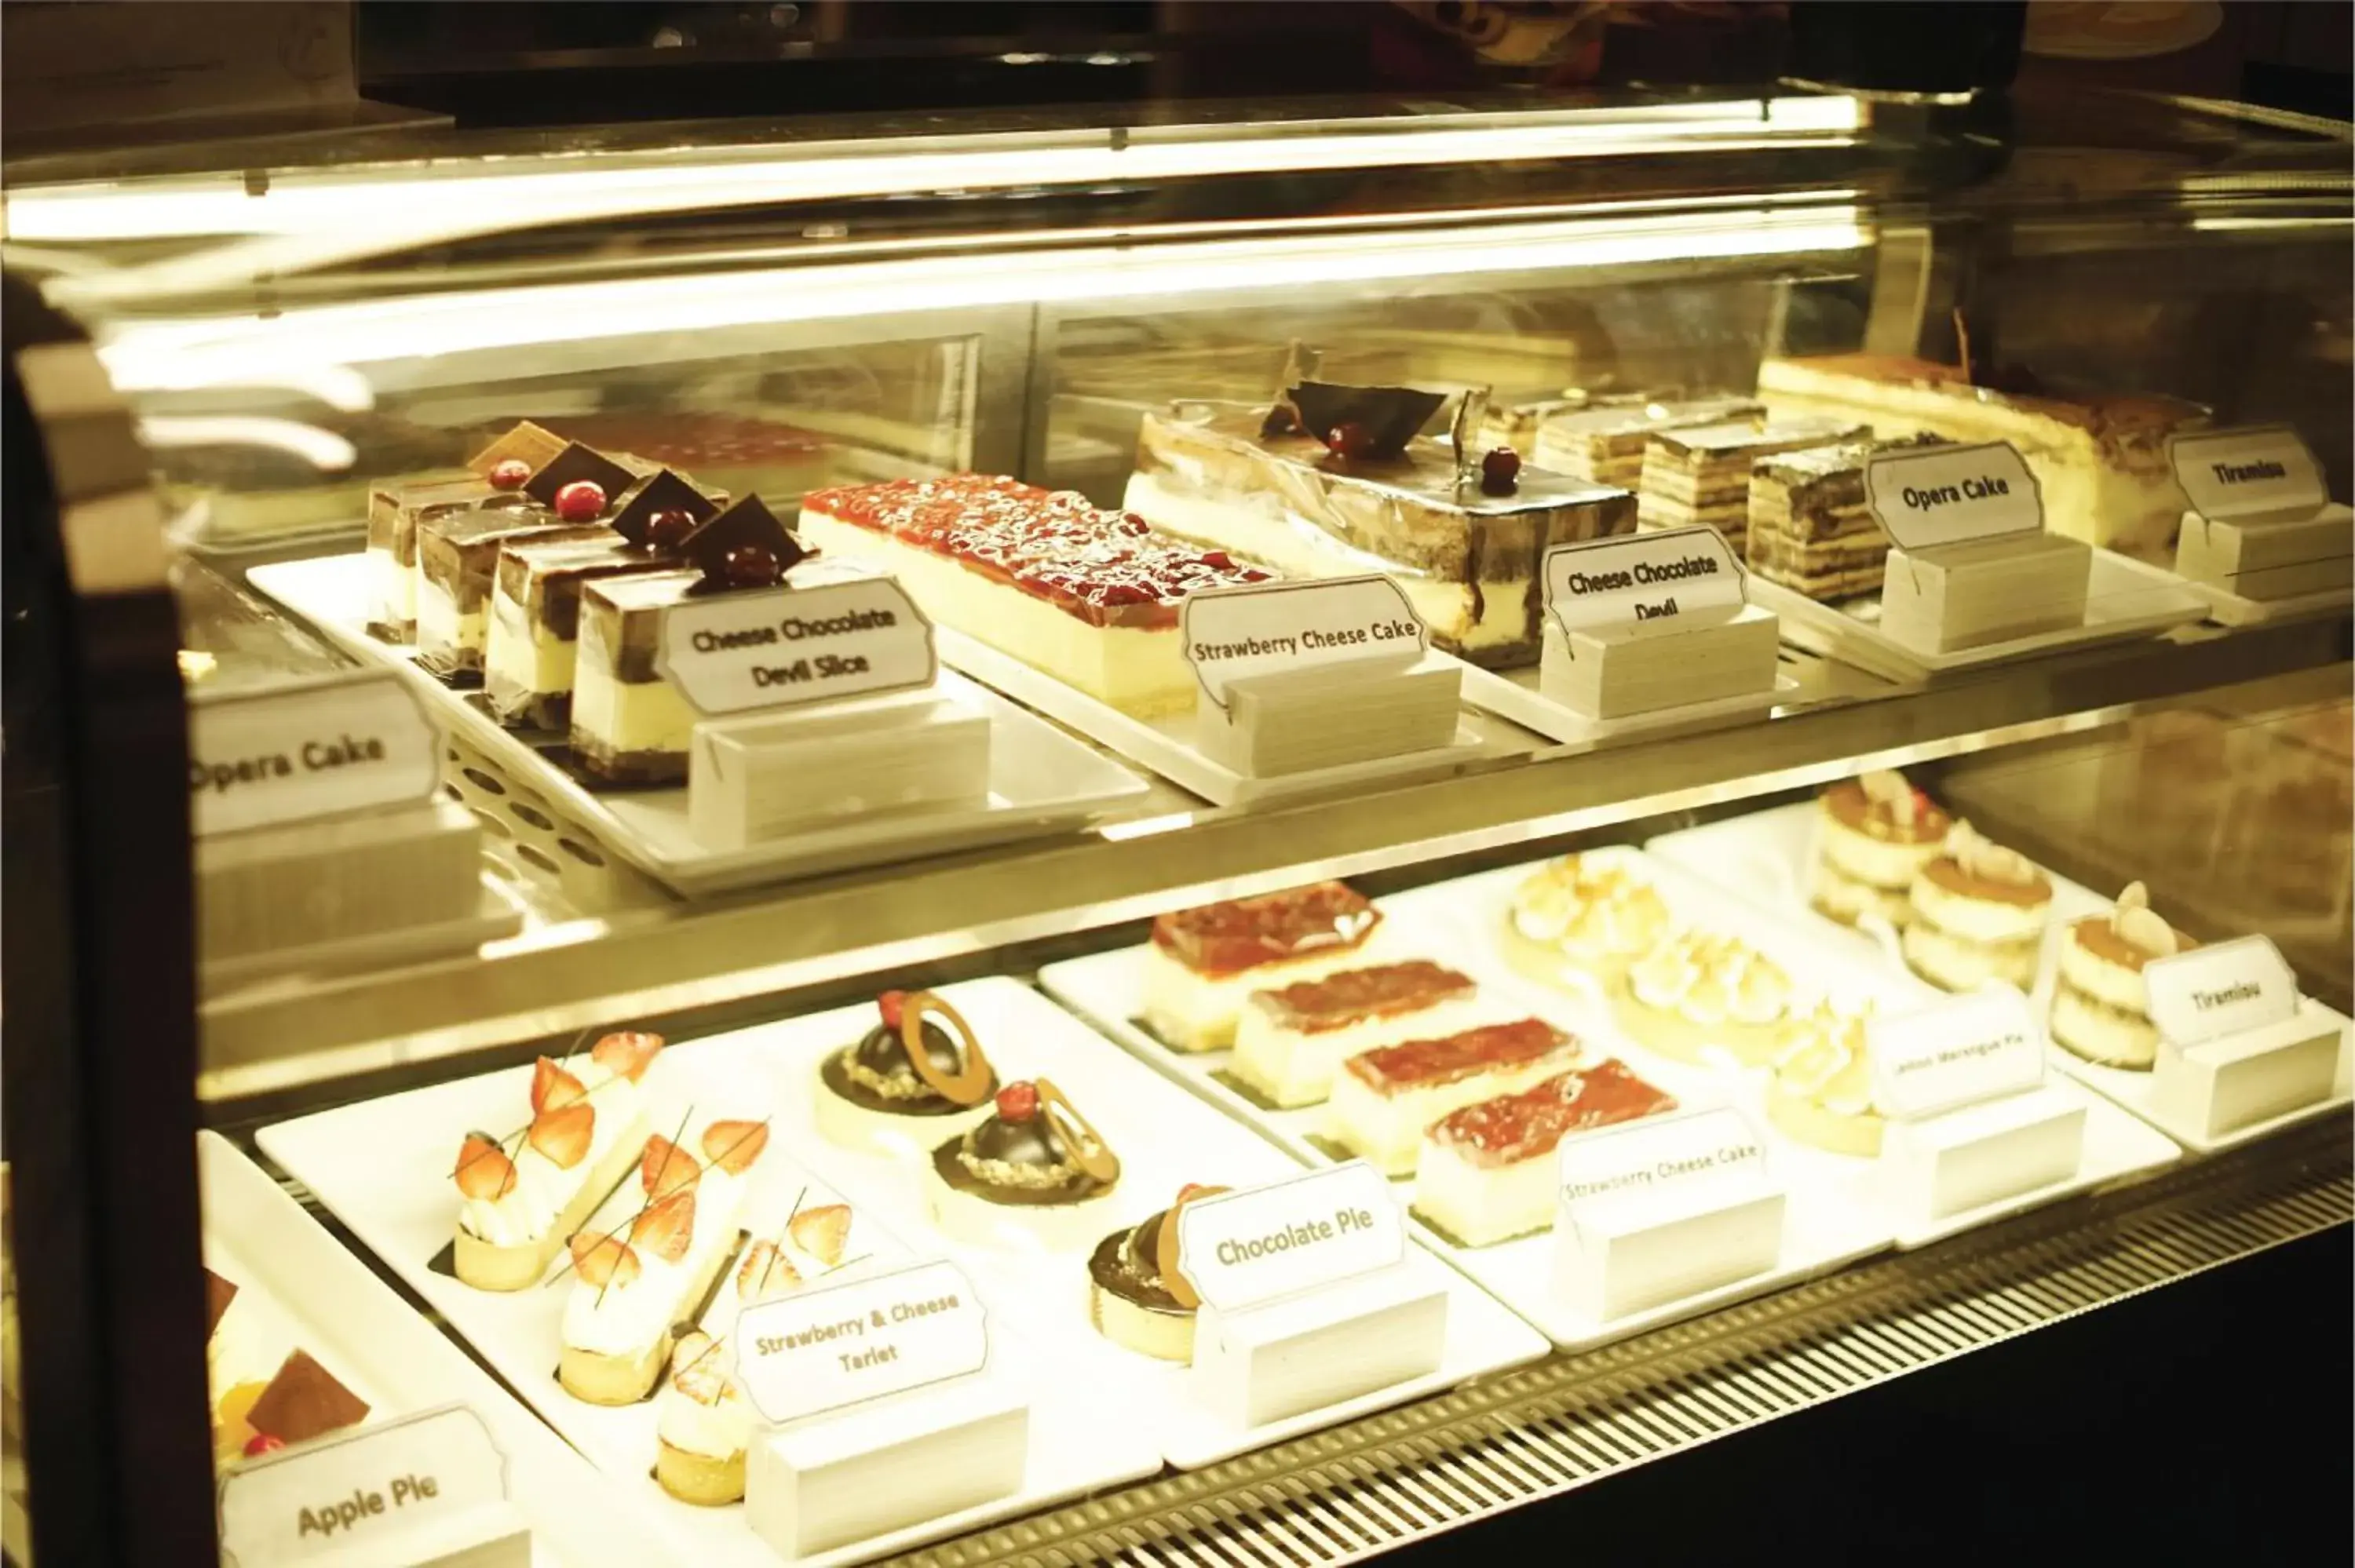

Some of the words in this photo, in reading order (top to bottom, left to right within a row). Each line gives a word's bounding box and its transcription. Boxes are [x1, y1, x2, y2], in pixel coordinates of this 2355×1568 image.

[2211, 459, 2286, 485] Tiramisu
[1902, 485, 1961, 512] Opera
[1962, 475, 2010, 500] Cake
[1568, 571, 1634, 595] Cheese
[1634, 555, 1718, 585] Chocolate
[1634, 596, 1679, 621] Devil
[692, 627, 778, 653] Cheese
[781, 609, 896, 640] Chocolate
[1194, 636, 1297, 662] Strawberry
[1302, 630, 1367, 649] Cheese
[1371, 619, 1417, 640] Cake
[751, 659, 812, 687] Devil
[814, 655, 870, 678] Slice
[301, 734, 386, 771] Cake
[2192, 980, 2262, 1009] Tiramisu
[1565, 1170, 1652, 1200] Strawberry
[1657, 1155, 1714, 1179] Cheese
[1717, 1145, 1758, 1164] Cake
[1217, 1223, 1334, 1266] Chocolate
[1335, 1207, 1374, 1234] Pie
[755, 1323, 864, 1356] Strawberry
[870, 1308, 886, 1328] &
[890, 1295, 959, 1323] Cheese
[298, 1488, 385, 1538] Apple
[389, 1473, 439, 1508] Pie
